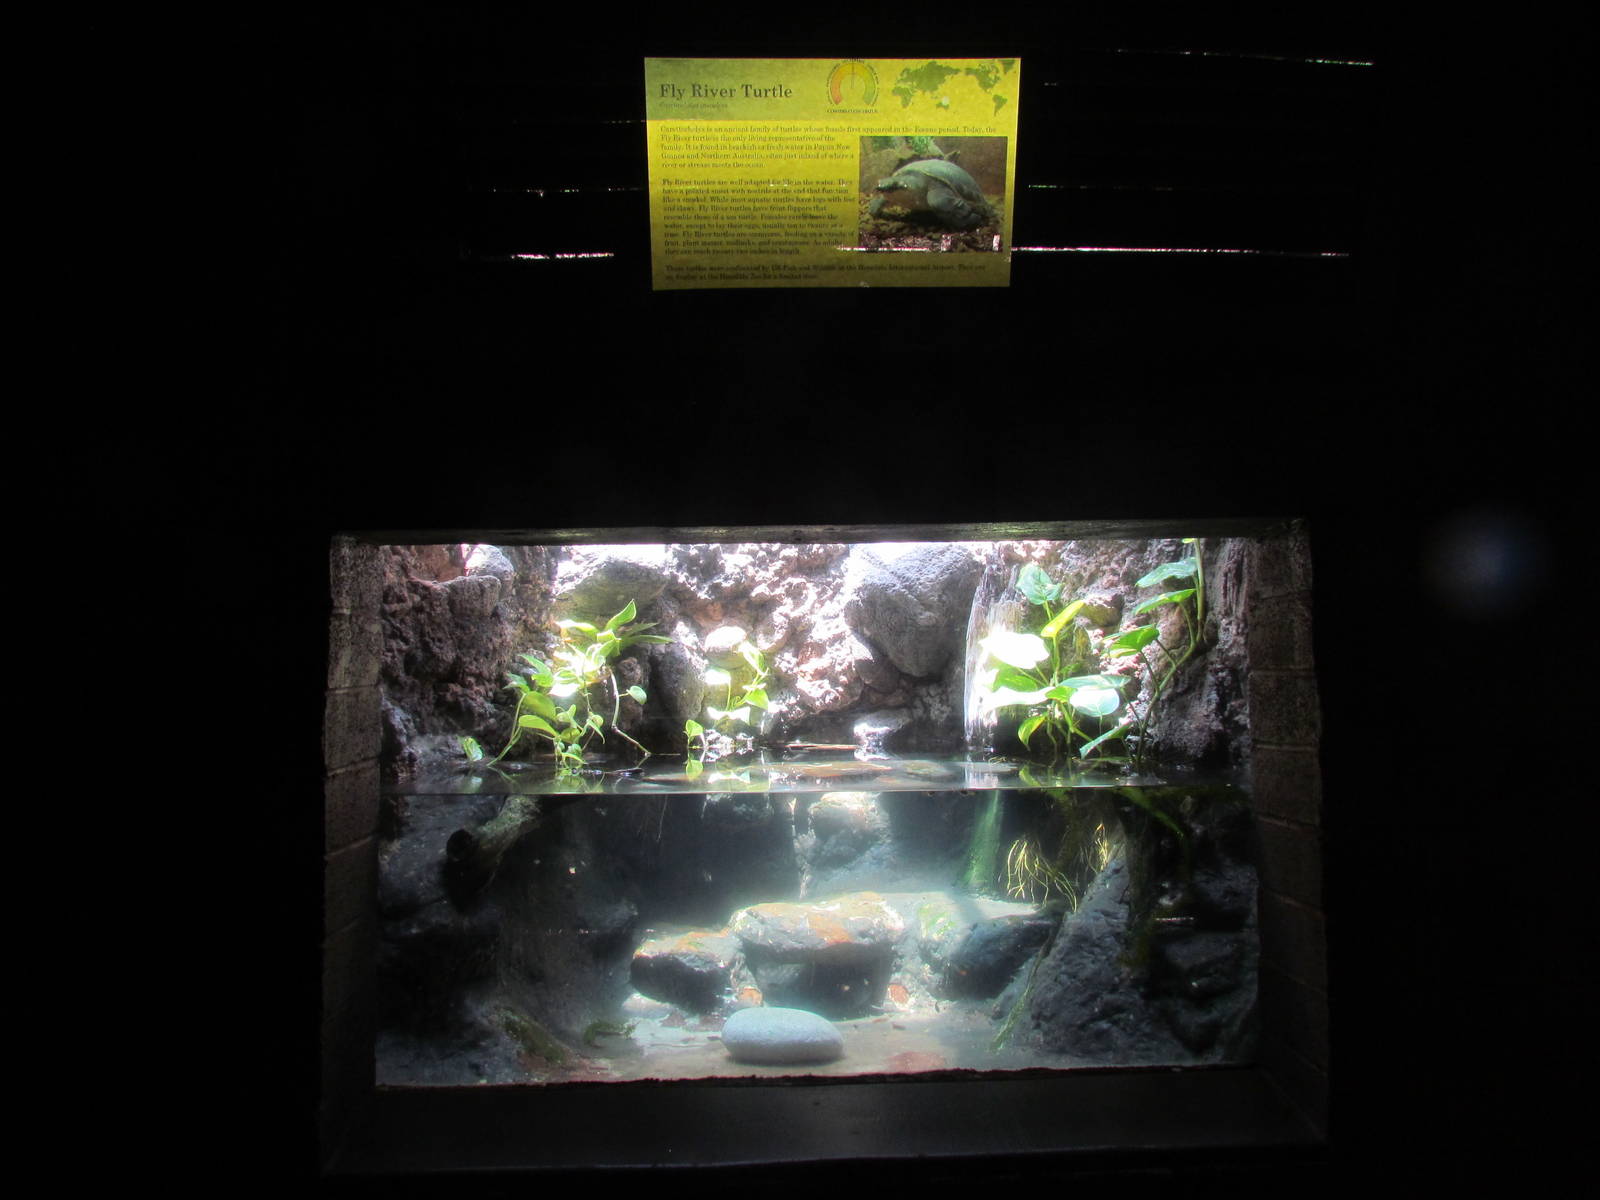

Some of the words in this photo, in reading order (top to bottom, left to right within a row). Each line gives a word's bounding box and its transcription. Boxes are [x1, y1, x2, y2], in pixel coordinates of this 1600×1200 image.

[660, 83, 685, 100] Fly
[691, 83, 736, 98] River
[741, 83, 793, 98] Turtle
[750, 126, 770, 134] family
